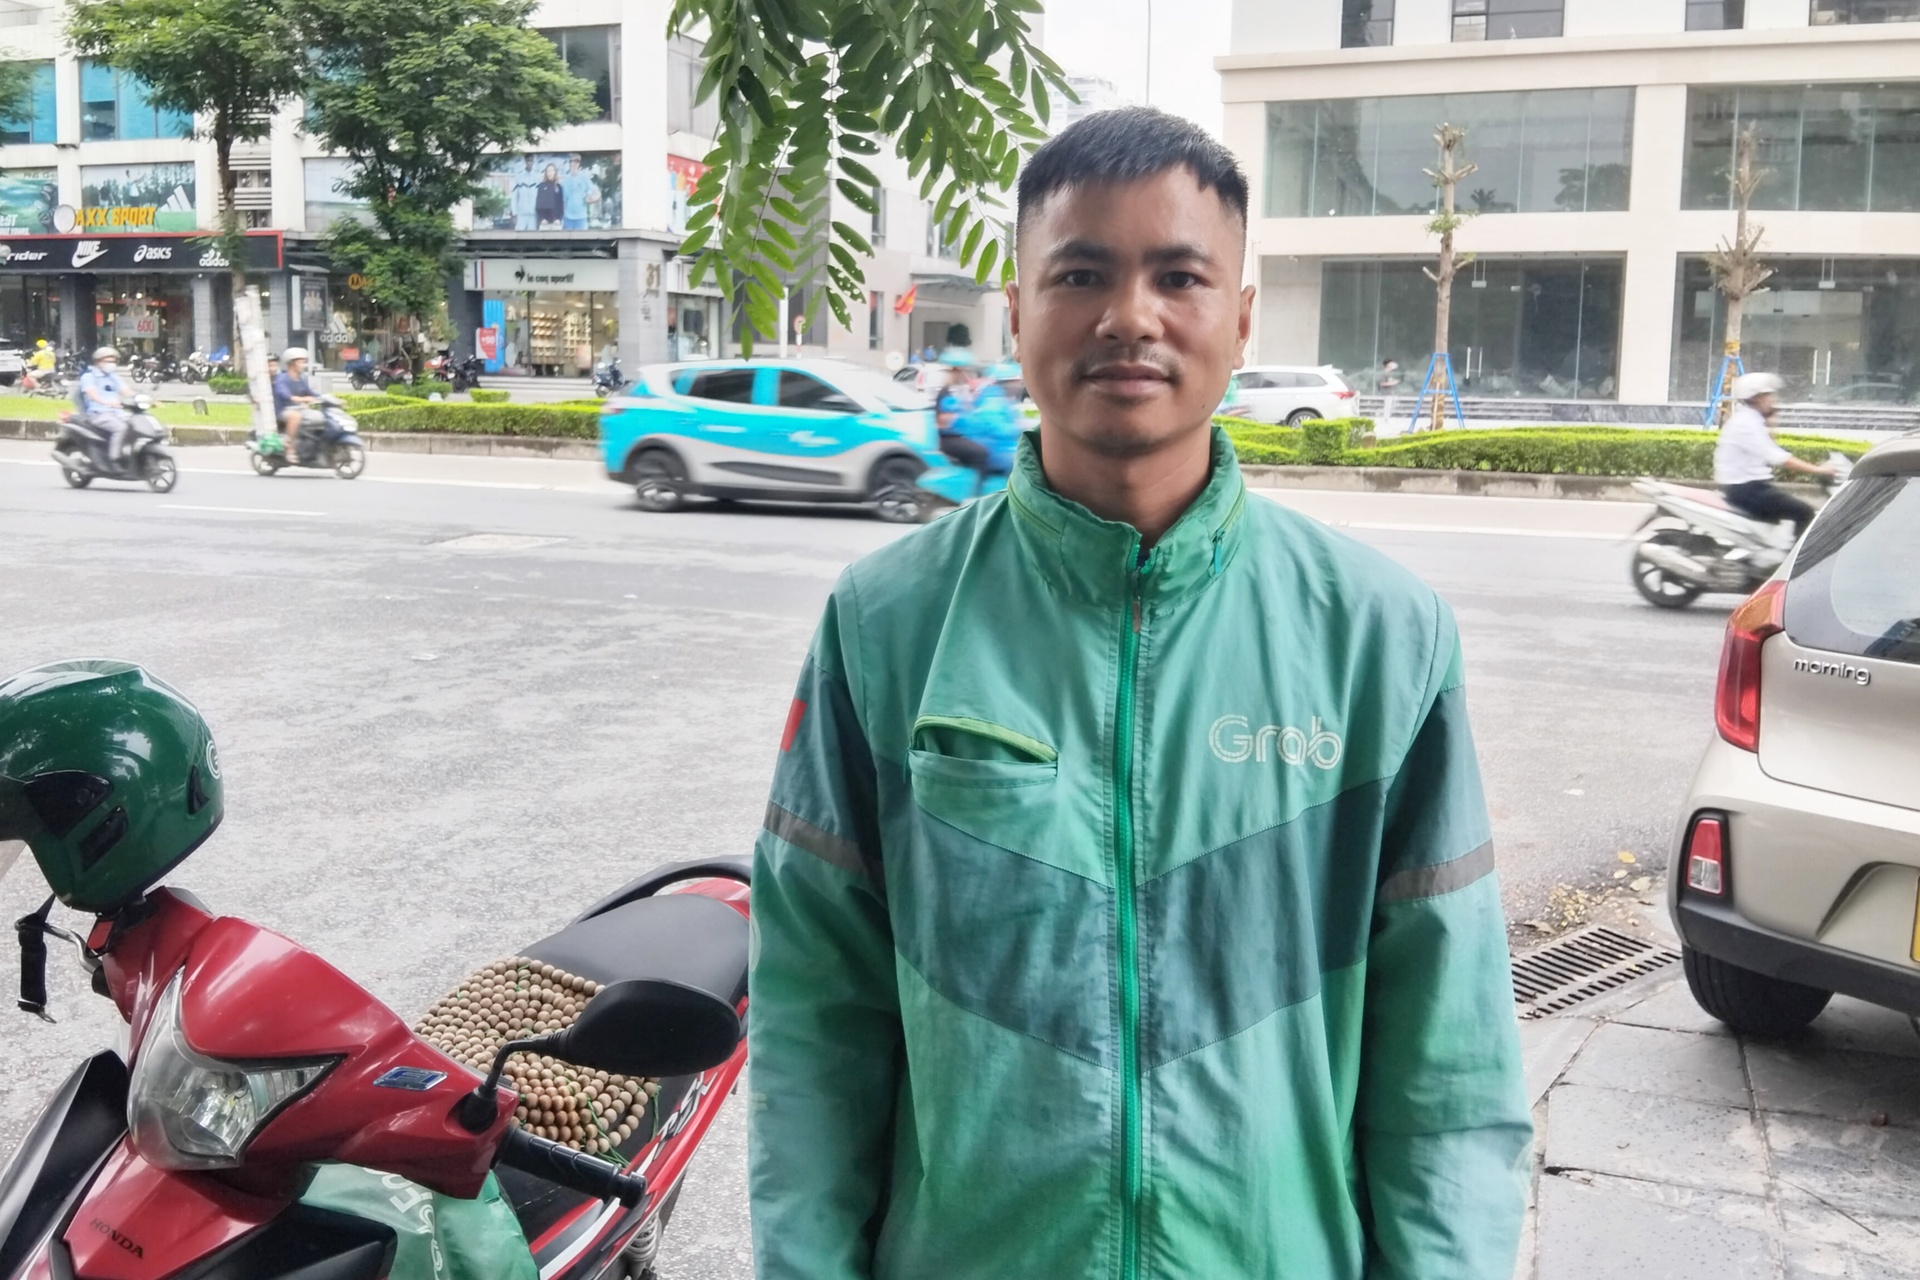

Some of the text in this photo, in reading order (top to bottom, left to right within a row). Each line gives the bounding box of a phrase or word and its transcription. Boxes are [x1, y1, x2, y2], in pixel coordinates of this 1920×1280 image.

[111, 206, 158, 226] SPORT
[77, 240, 102, 256] NIKE
[1793, 658, 1871, 686] morning
[1208, 714, 1343, 770] Grab
[90, 1218, 145, 1260] HONDA
